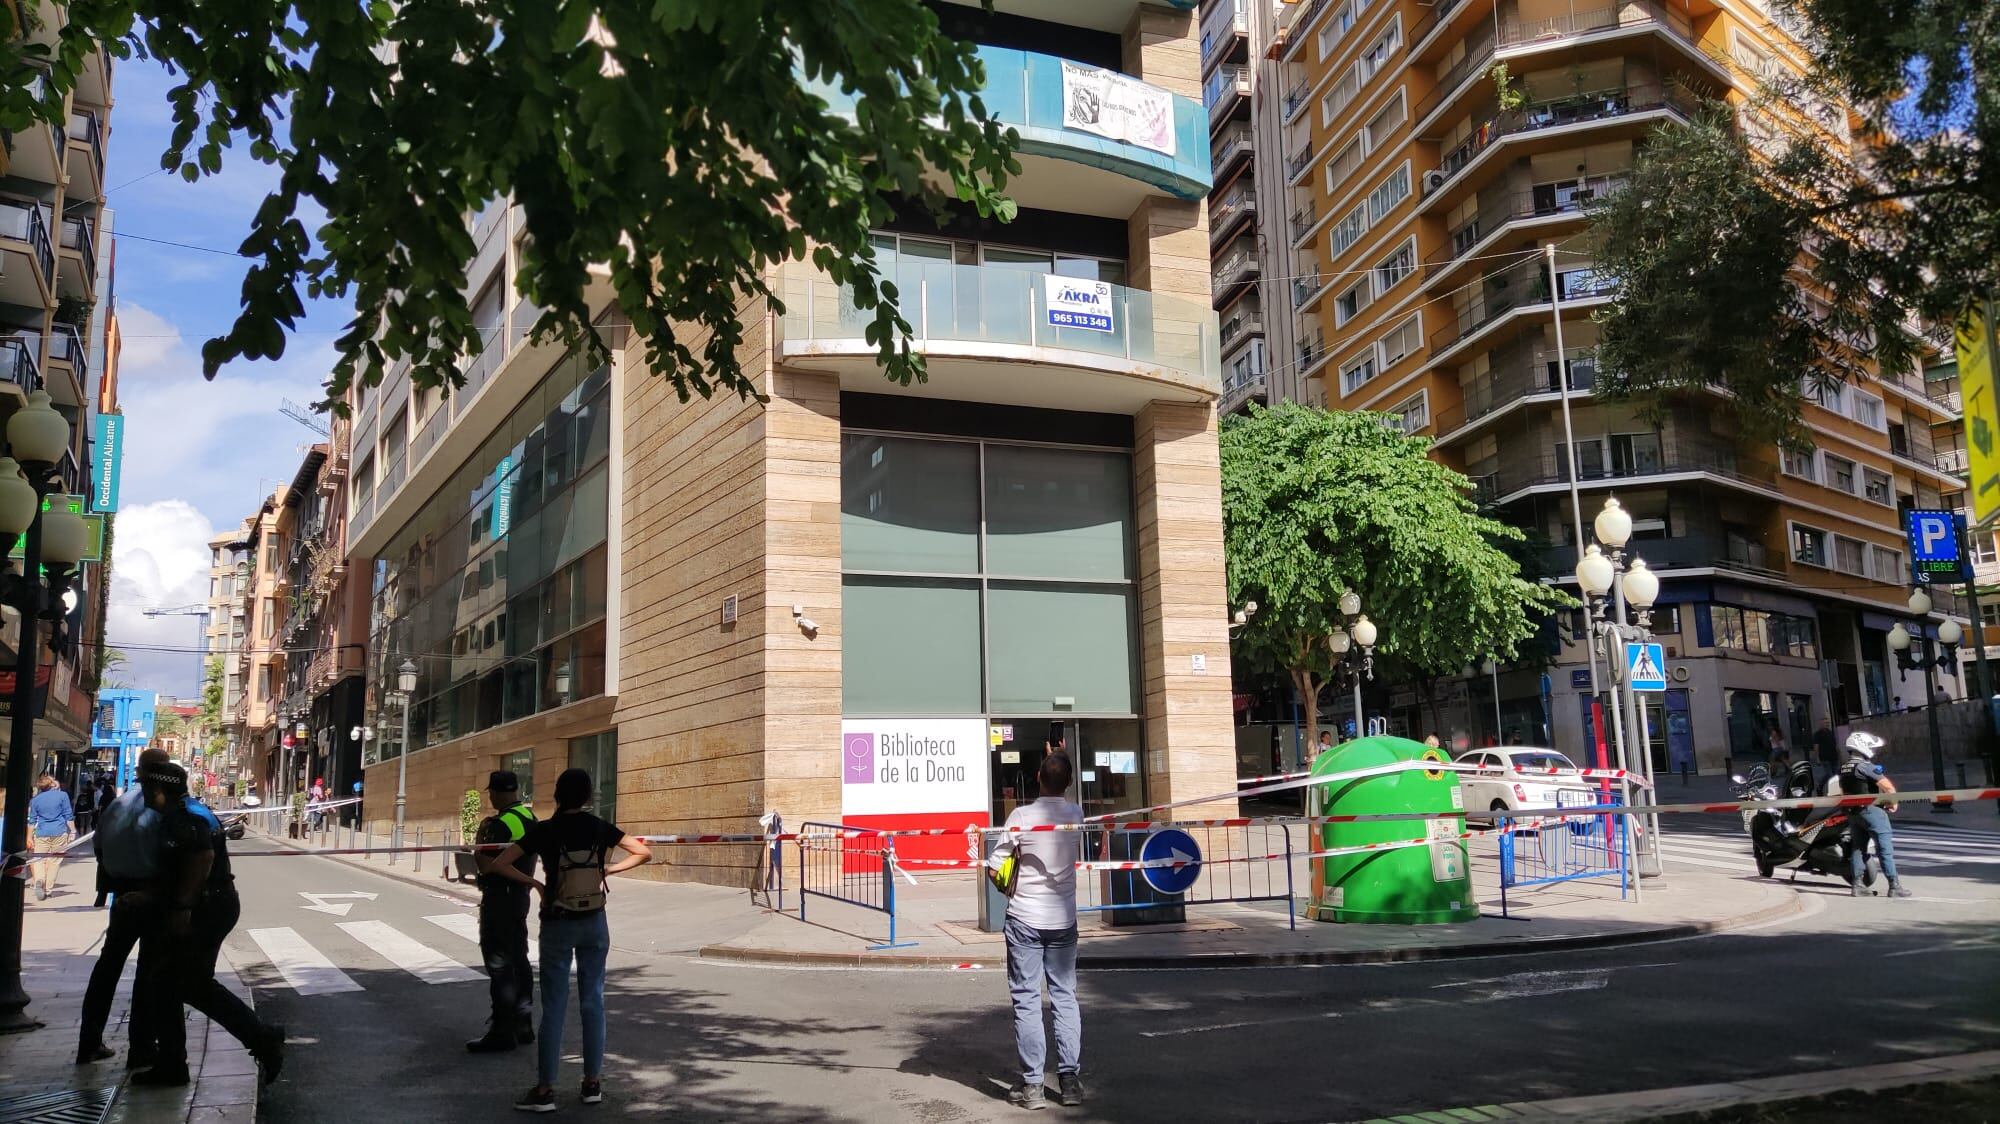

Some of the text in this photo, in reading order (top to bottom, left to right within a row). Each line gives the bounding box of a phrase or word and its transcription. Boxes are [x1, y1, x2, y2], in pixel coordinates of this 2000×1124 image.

[1064, 290, 1100, 305] AKRA
[1053, 313, 1107, 327] 965 113 348
[100, 420, 115, 507] Occidental Alicante
[1920, 518, 1946, 554] P
[1922, 562, 1956, 572] LIBRE
[881, 732, 955, 757] Biblioteca
[880, 758, 965, 784] de la Dona
